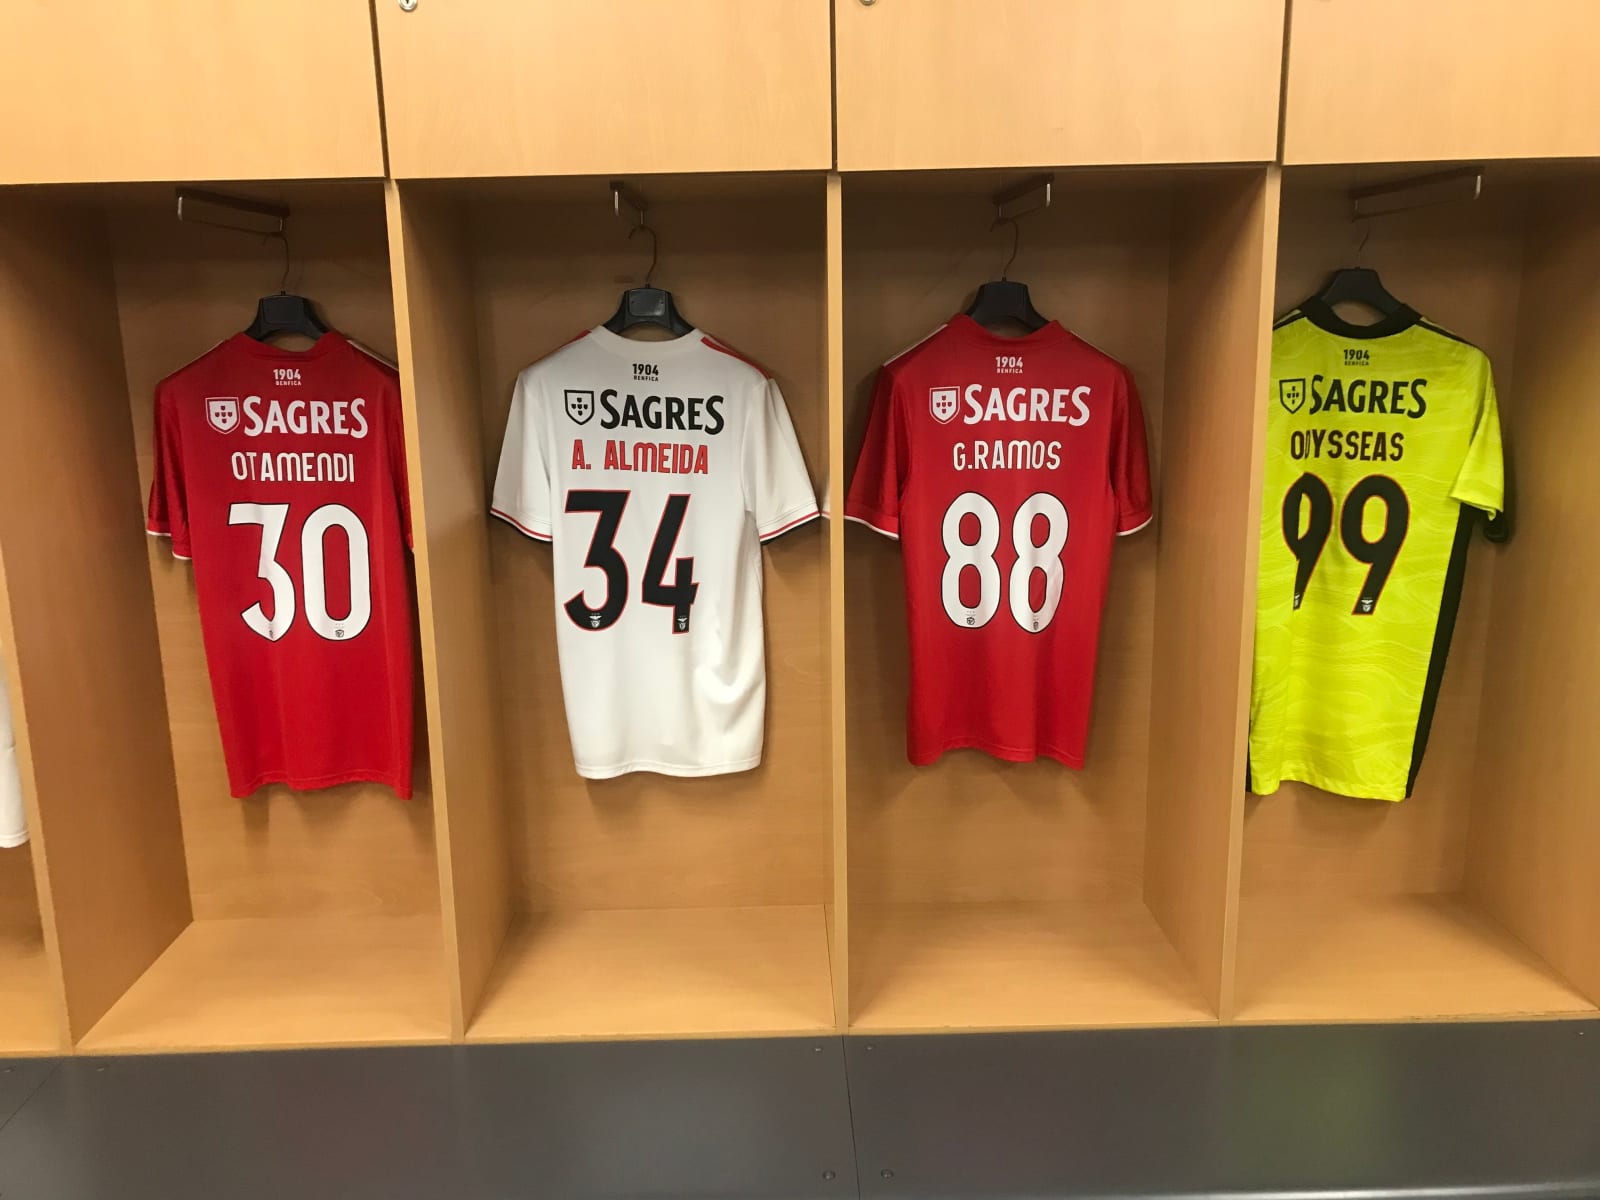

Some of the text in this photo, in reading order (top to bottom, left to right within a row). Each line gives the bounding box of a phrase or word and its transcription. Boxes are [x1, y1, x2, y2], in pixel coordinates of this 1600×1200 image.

[273, 368, 302, 380] 1904
[632, 363, 659, 376] 1904
[995, 356, 1024, 368] 1904
[1343, 349, 1370, 360] 1904
[242, 395, 369, 439] SAGRES
[600, 388, 726, 435] SAGRES
[964, 384, 1092, 427] SAGRES
[1309, 374, 1429, 419] SAGRES
[230, 451, 355, 483] OTAMENDI
[571, 438, 709, 475] A. ALMEIDA
[953, 439, 1063, 471] G.RAMOS
[563, 488, 700, 635] 34
[940, 490, 1070, 634] 88
[1281, 471, 1411, 616] 99
[228, 502, 373, 642] 30
